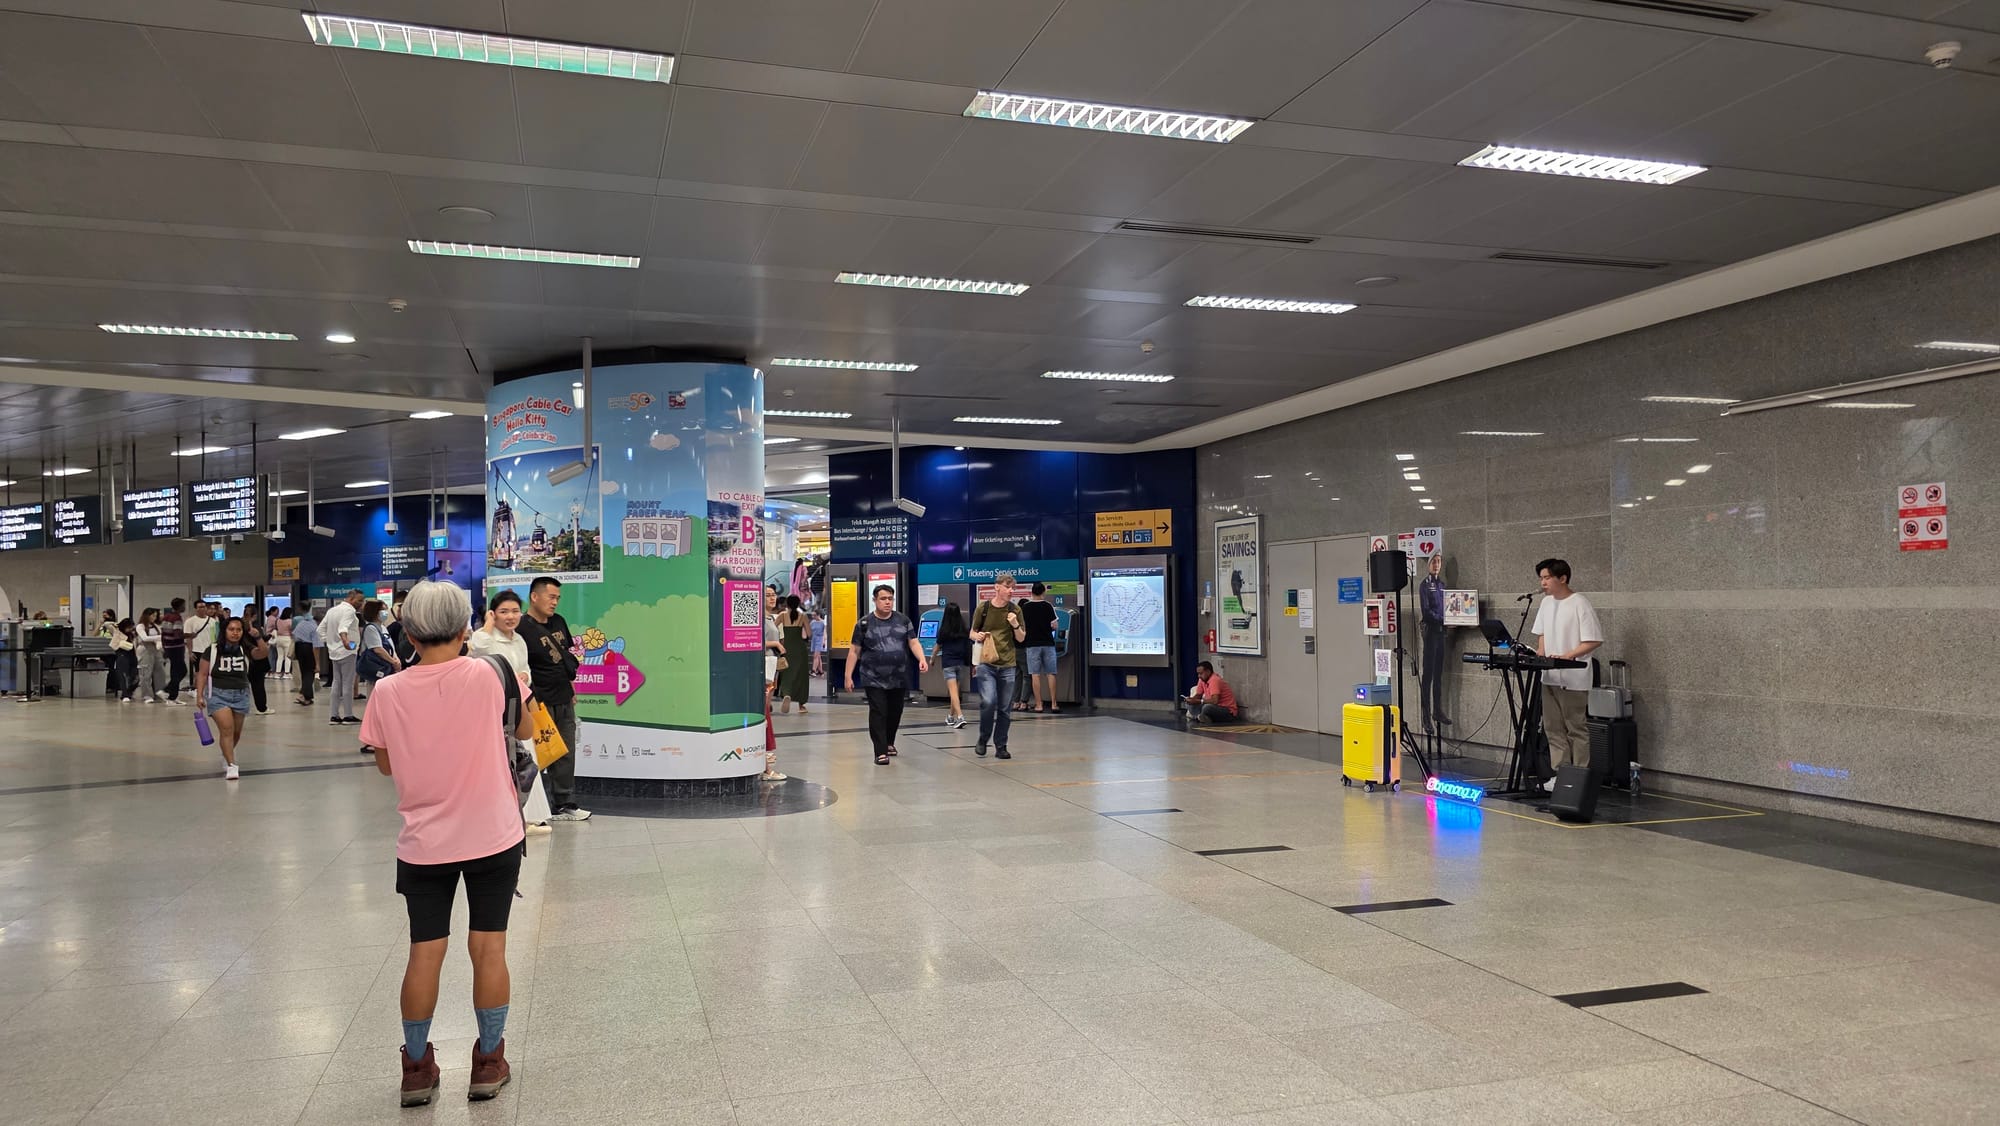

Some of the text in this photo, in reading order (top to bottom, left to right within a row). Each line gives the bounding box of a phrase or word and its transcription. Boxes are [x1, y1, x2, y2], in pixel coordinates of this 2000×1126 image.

[493, 397, 572, 427] Singapore Cable Car
[506, 413, 546, 432] Hello Kitty
[733, 493, 756, 502] CABLE
[627, 500, 662, 509] MOUNT
[742, 503, 755, 511] EXIT
[742, 516, 755, 543] B
[985, 536, 1002, 544] ticketing
[1124, 534, 1130, 542] A
[732, 548, 753, 556] HEAD
[1222, 541, 1256, 558] SAVINGS
[732, 566, 756, 574] TOWER
[967, 567, 1039, 579] Ticketing Service Kiosks
[1056, 597, 1064, 605] 04
[618, 672, 630, 693] B
